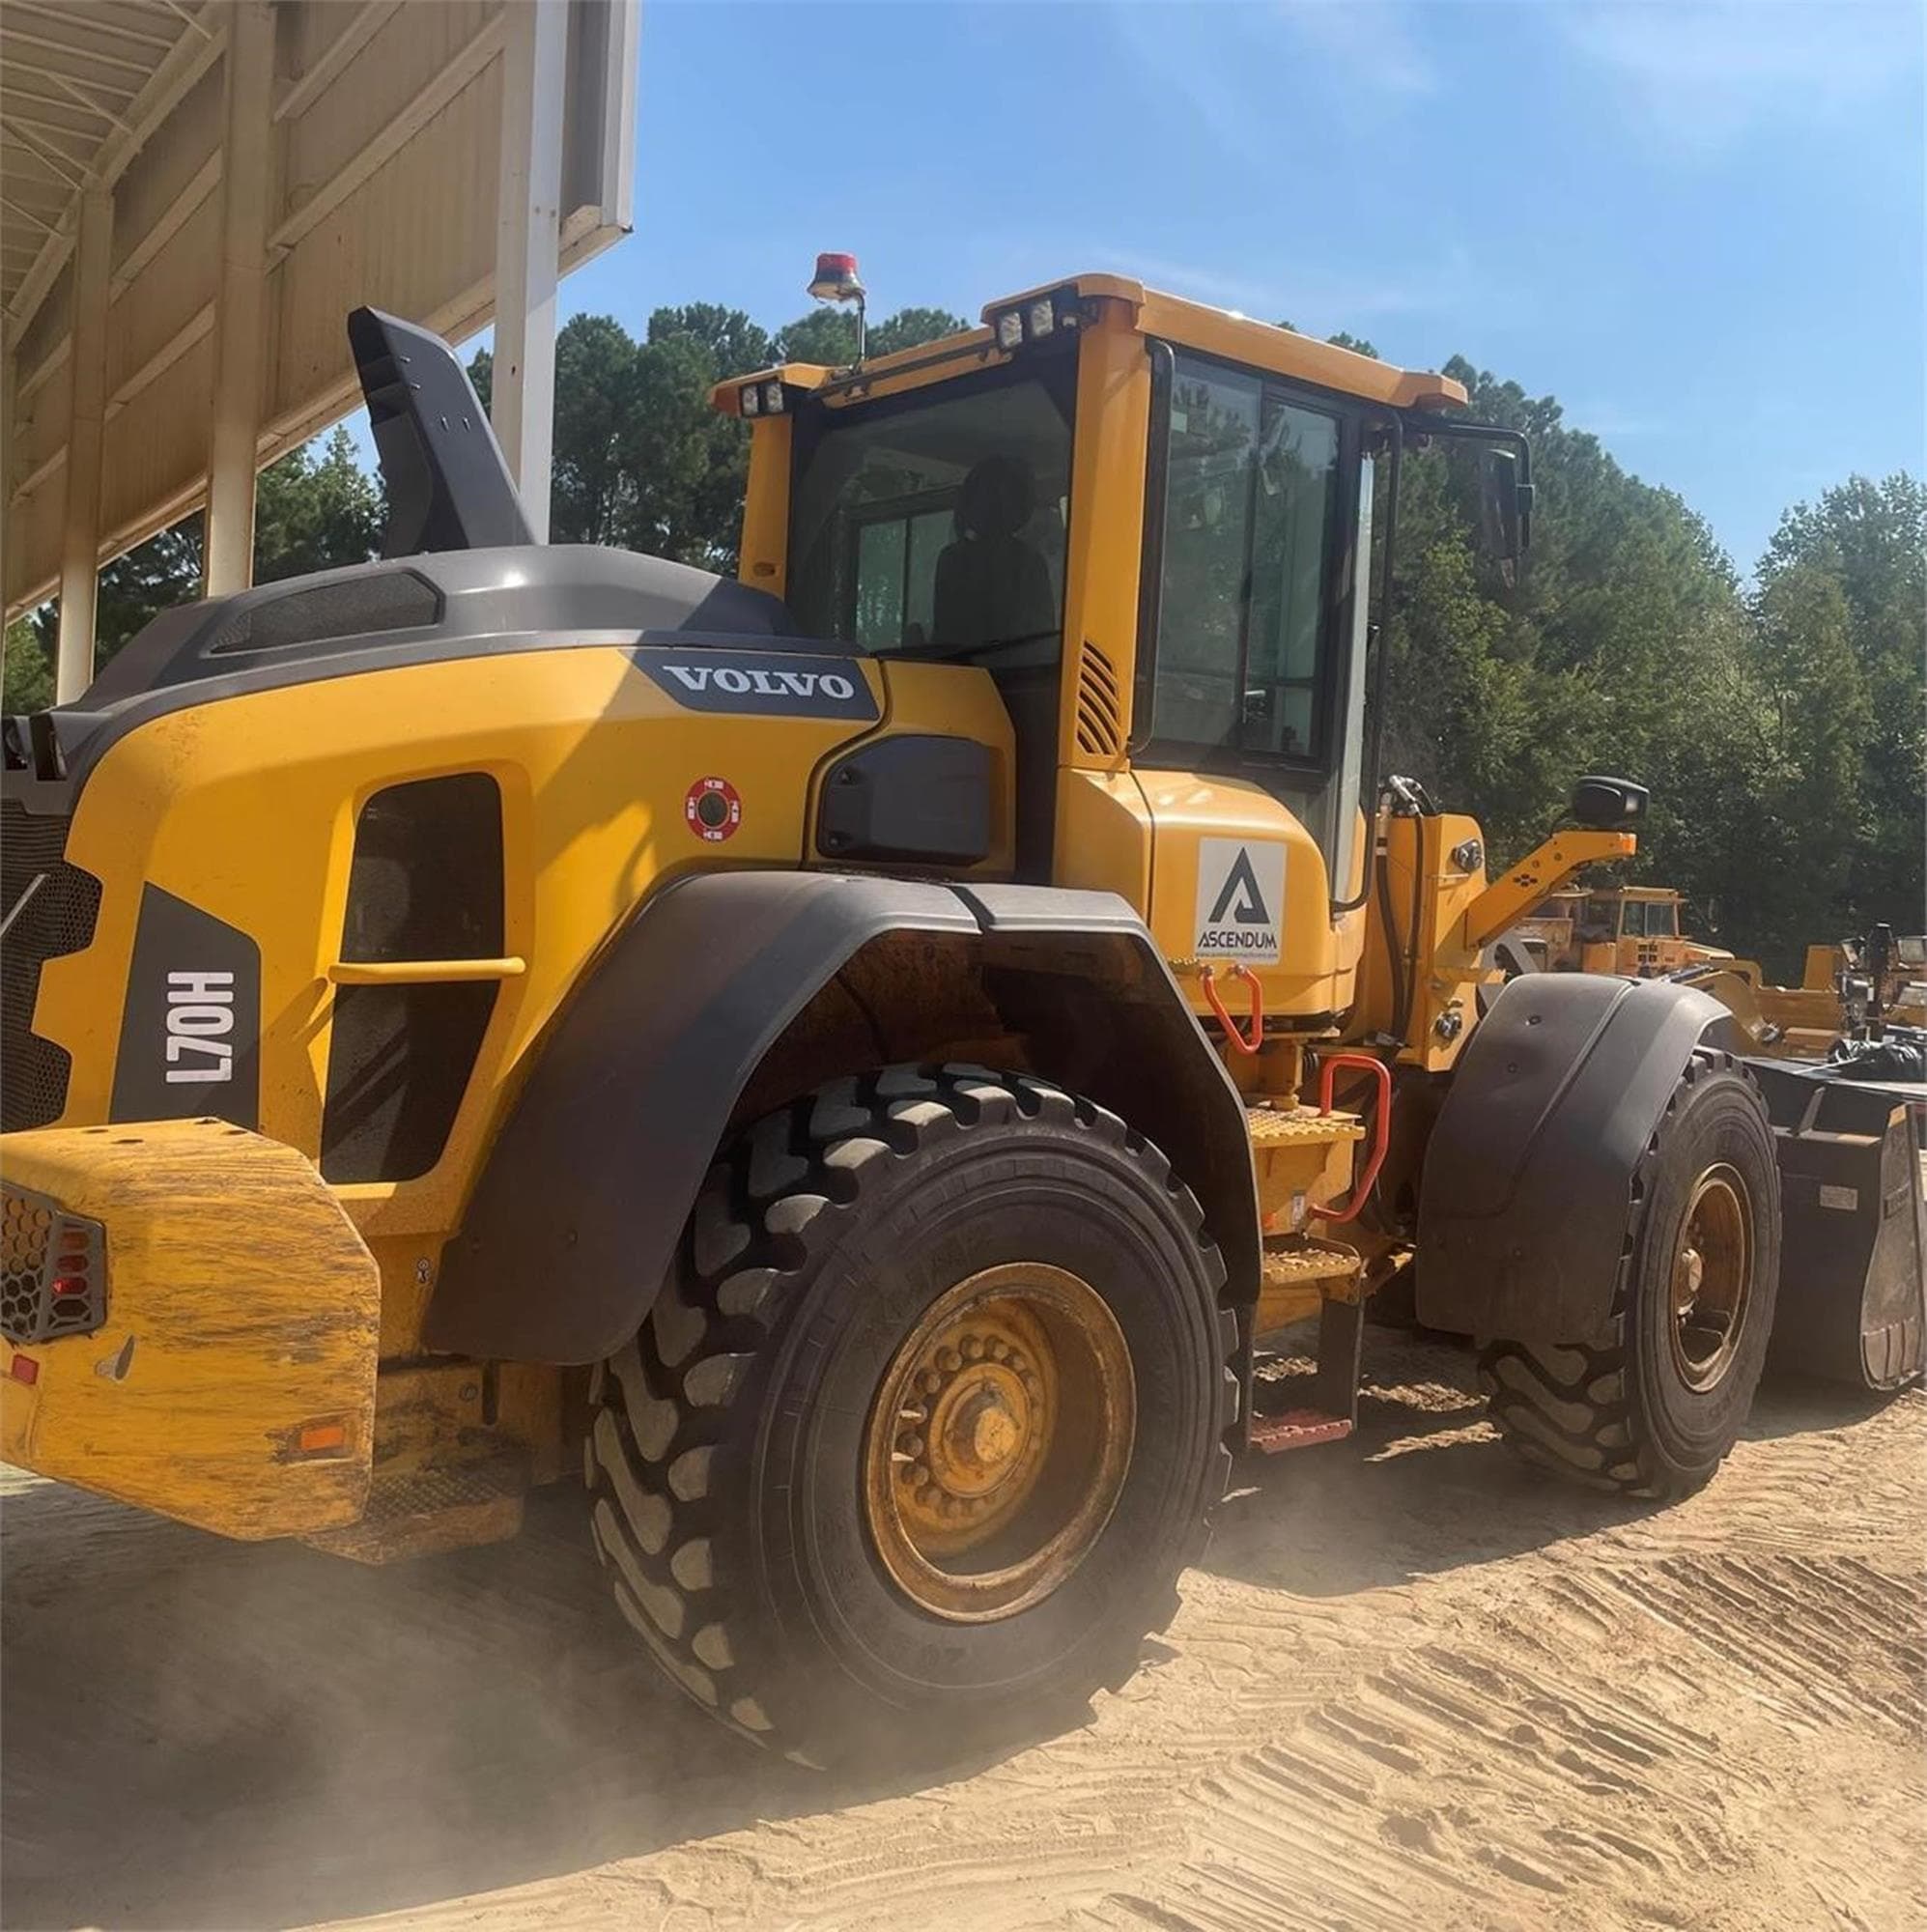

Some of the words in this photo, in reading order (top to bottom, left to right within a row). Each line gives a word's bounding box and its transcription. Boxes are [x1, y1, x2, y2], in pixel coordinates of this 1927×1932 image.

[663, 666, 855, 699] VOLVO
[1198, 931, 1277, 949] ASCENDUM
[166, 972, 234, 1083] L70H
